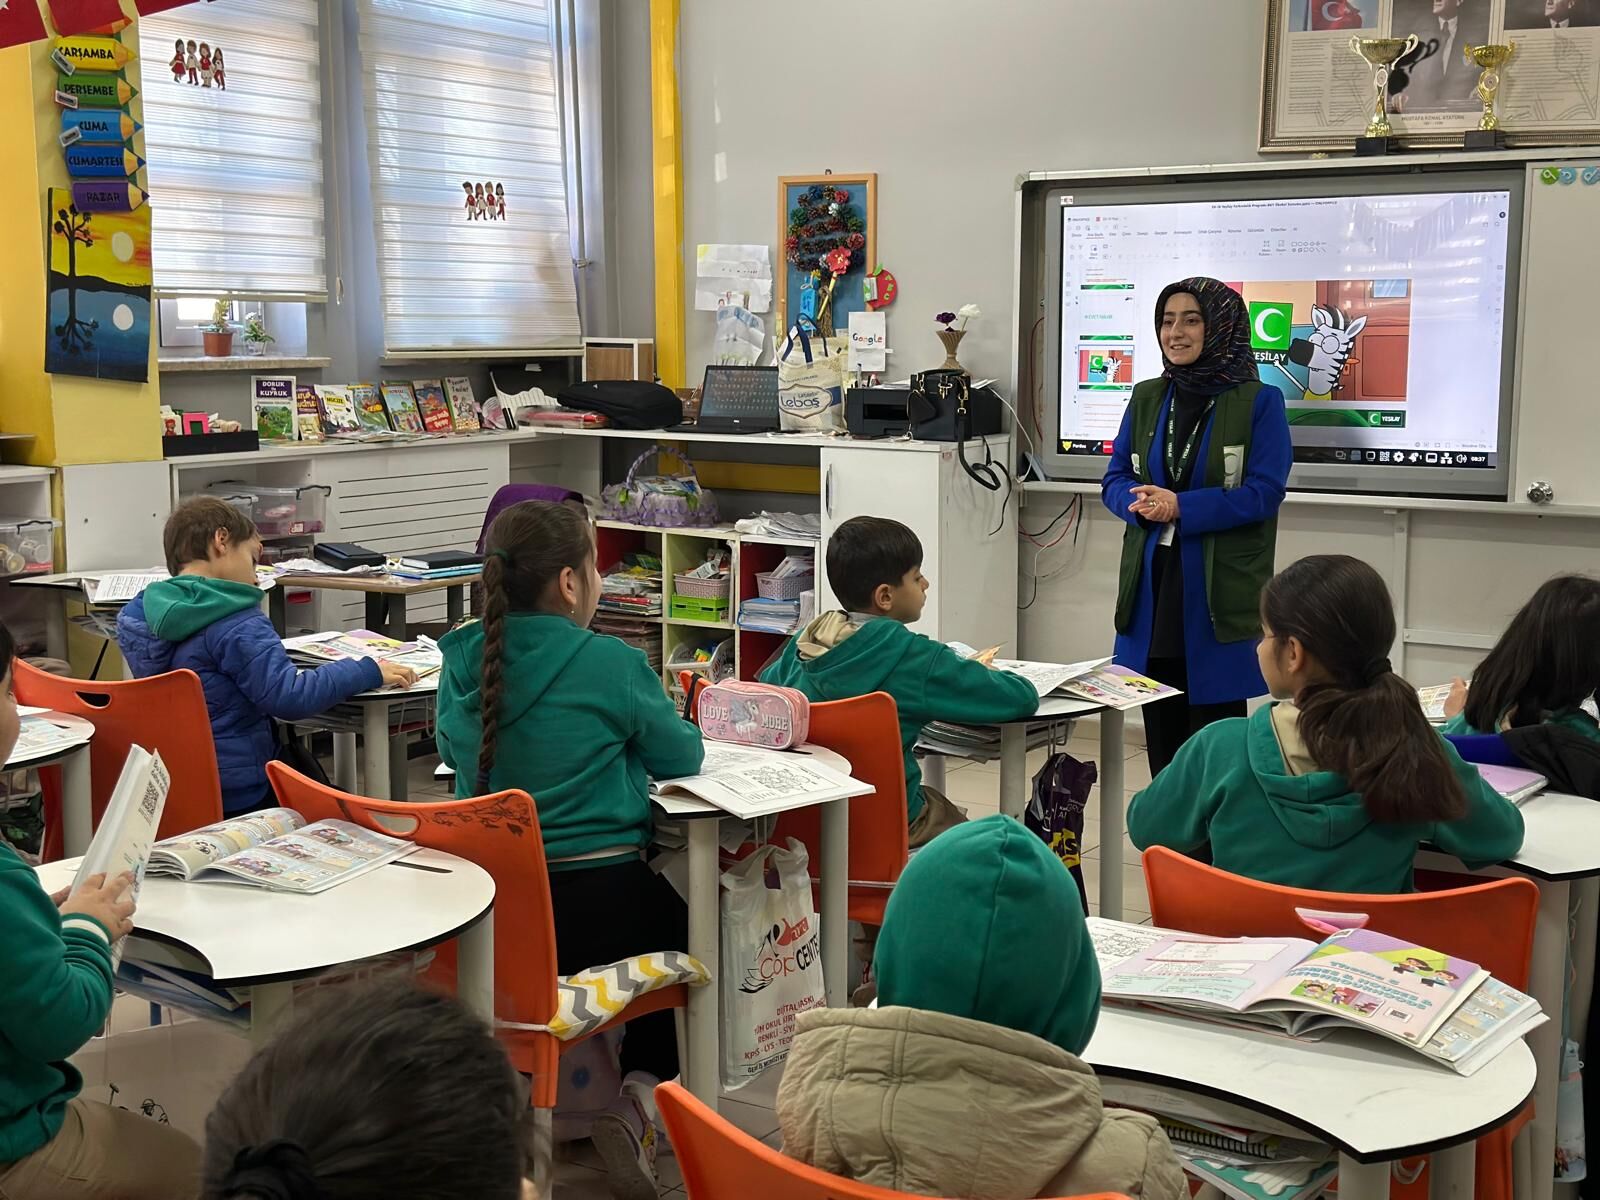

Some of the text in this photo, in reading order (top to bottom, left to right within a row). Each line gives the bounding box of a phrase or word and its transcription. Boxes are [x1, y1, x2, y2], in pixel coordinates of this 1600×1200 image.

[79, 120, 109, 132] CUMA
[86, 191, 121, 202] PAZAR
[703, 704, 729, 722] LOVE
[761, 713, 789, 731] MORE
